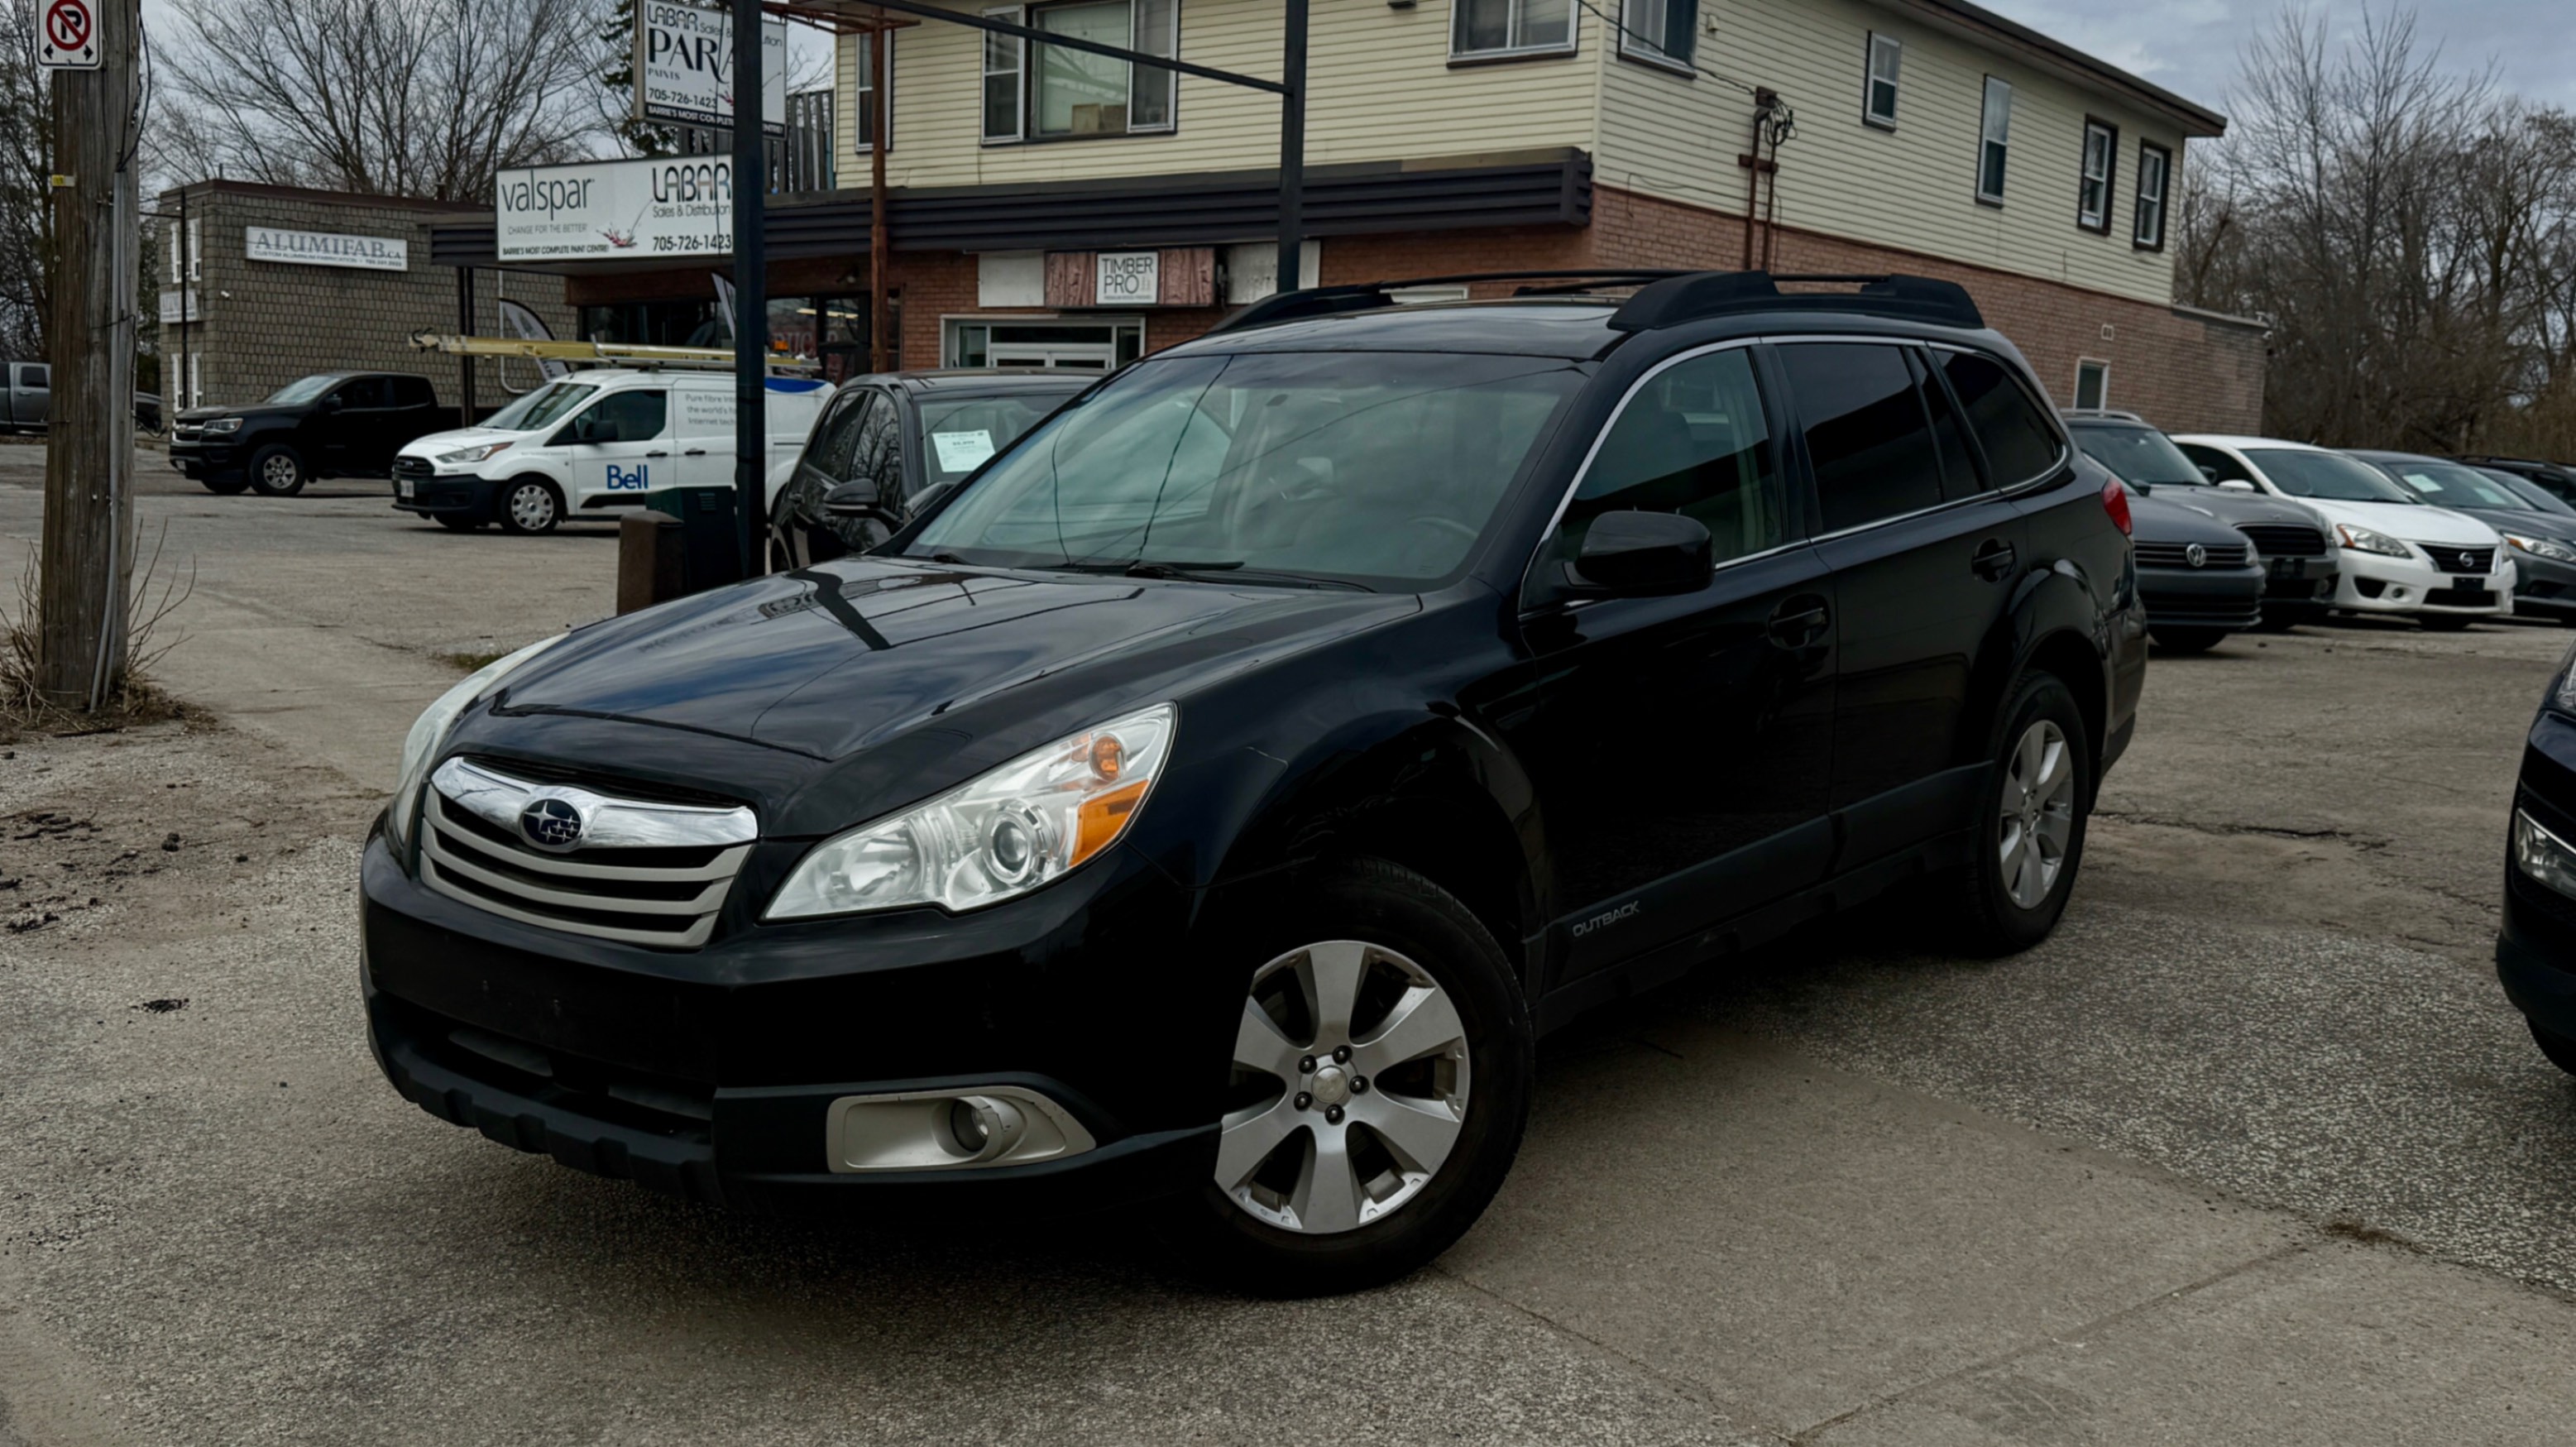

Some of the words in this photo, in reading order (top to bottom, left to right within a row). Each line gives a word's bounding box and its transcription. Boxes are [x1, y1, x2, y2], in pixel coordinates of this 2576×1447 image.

[647, 4, 698, 31] LABAR
[700, 22, 722, 36] Sale
[648, 68, 681, 81] PAINTS
[648, 88, 717, 109] 705-726-1423
[678, 110, 699, 122] MOST
[652, 162, 731, 203] LABAR
[500, 168, 592, 222] valspar
[653, 206, 675, 218] Sales
[677, 204, 683, 217] &
[507, 226, 534, 235] CHANGE
[534, 224, 548, 234] FOR
[549, 223, 561, 234] THE
[563, 223, 587, 233] BETTER
[525, 247, 540, 255] MOST
[541, 246, 569, 255] COMPLETE
[571, 245, 586, 253] PAINT
[653, 234, 732, 252] 705-726-1423
[1102, 256, 1153, 274] TIMBER
[1104, 274, 1140, 295] PRO
[685, 393, 702, 402] Pure
[704, 394, 721, 403] fibre
[687, 405, 699, 414] the
[701, 406, 727, 414] world's
[688, 417, 718, 425] Internet
[606, 464, 649, 490] Bell
[1573, 900, 1640, 937] OUTBACK
